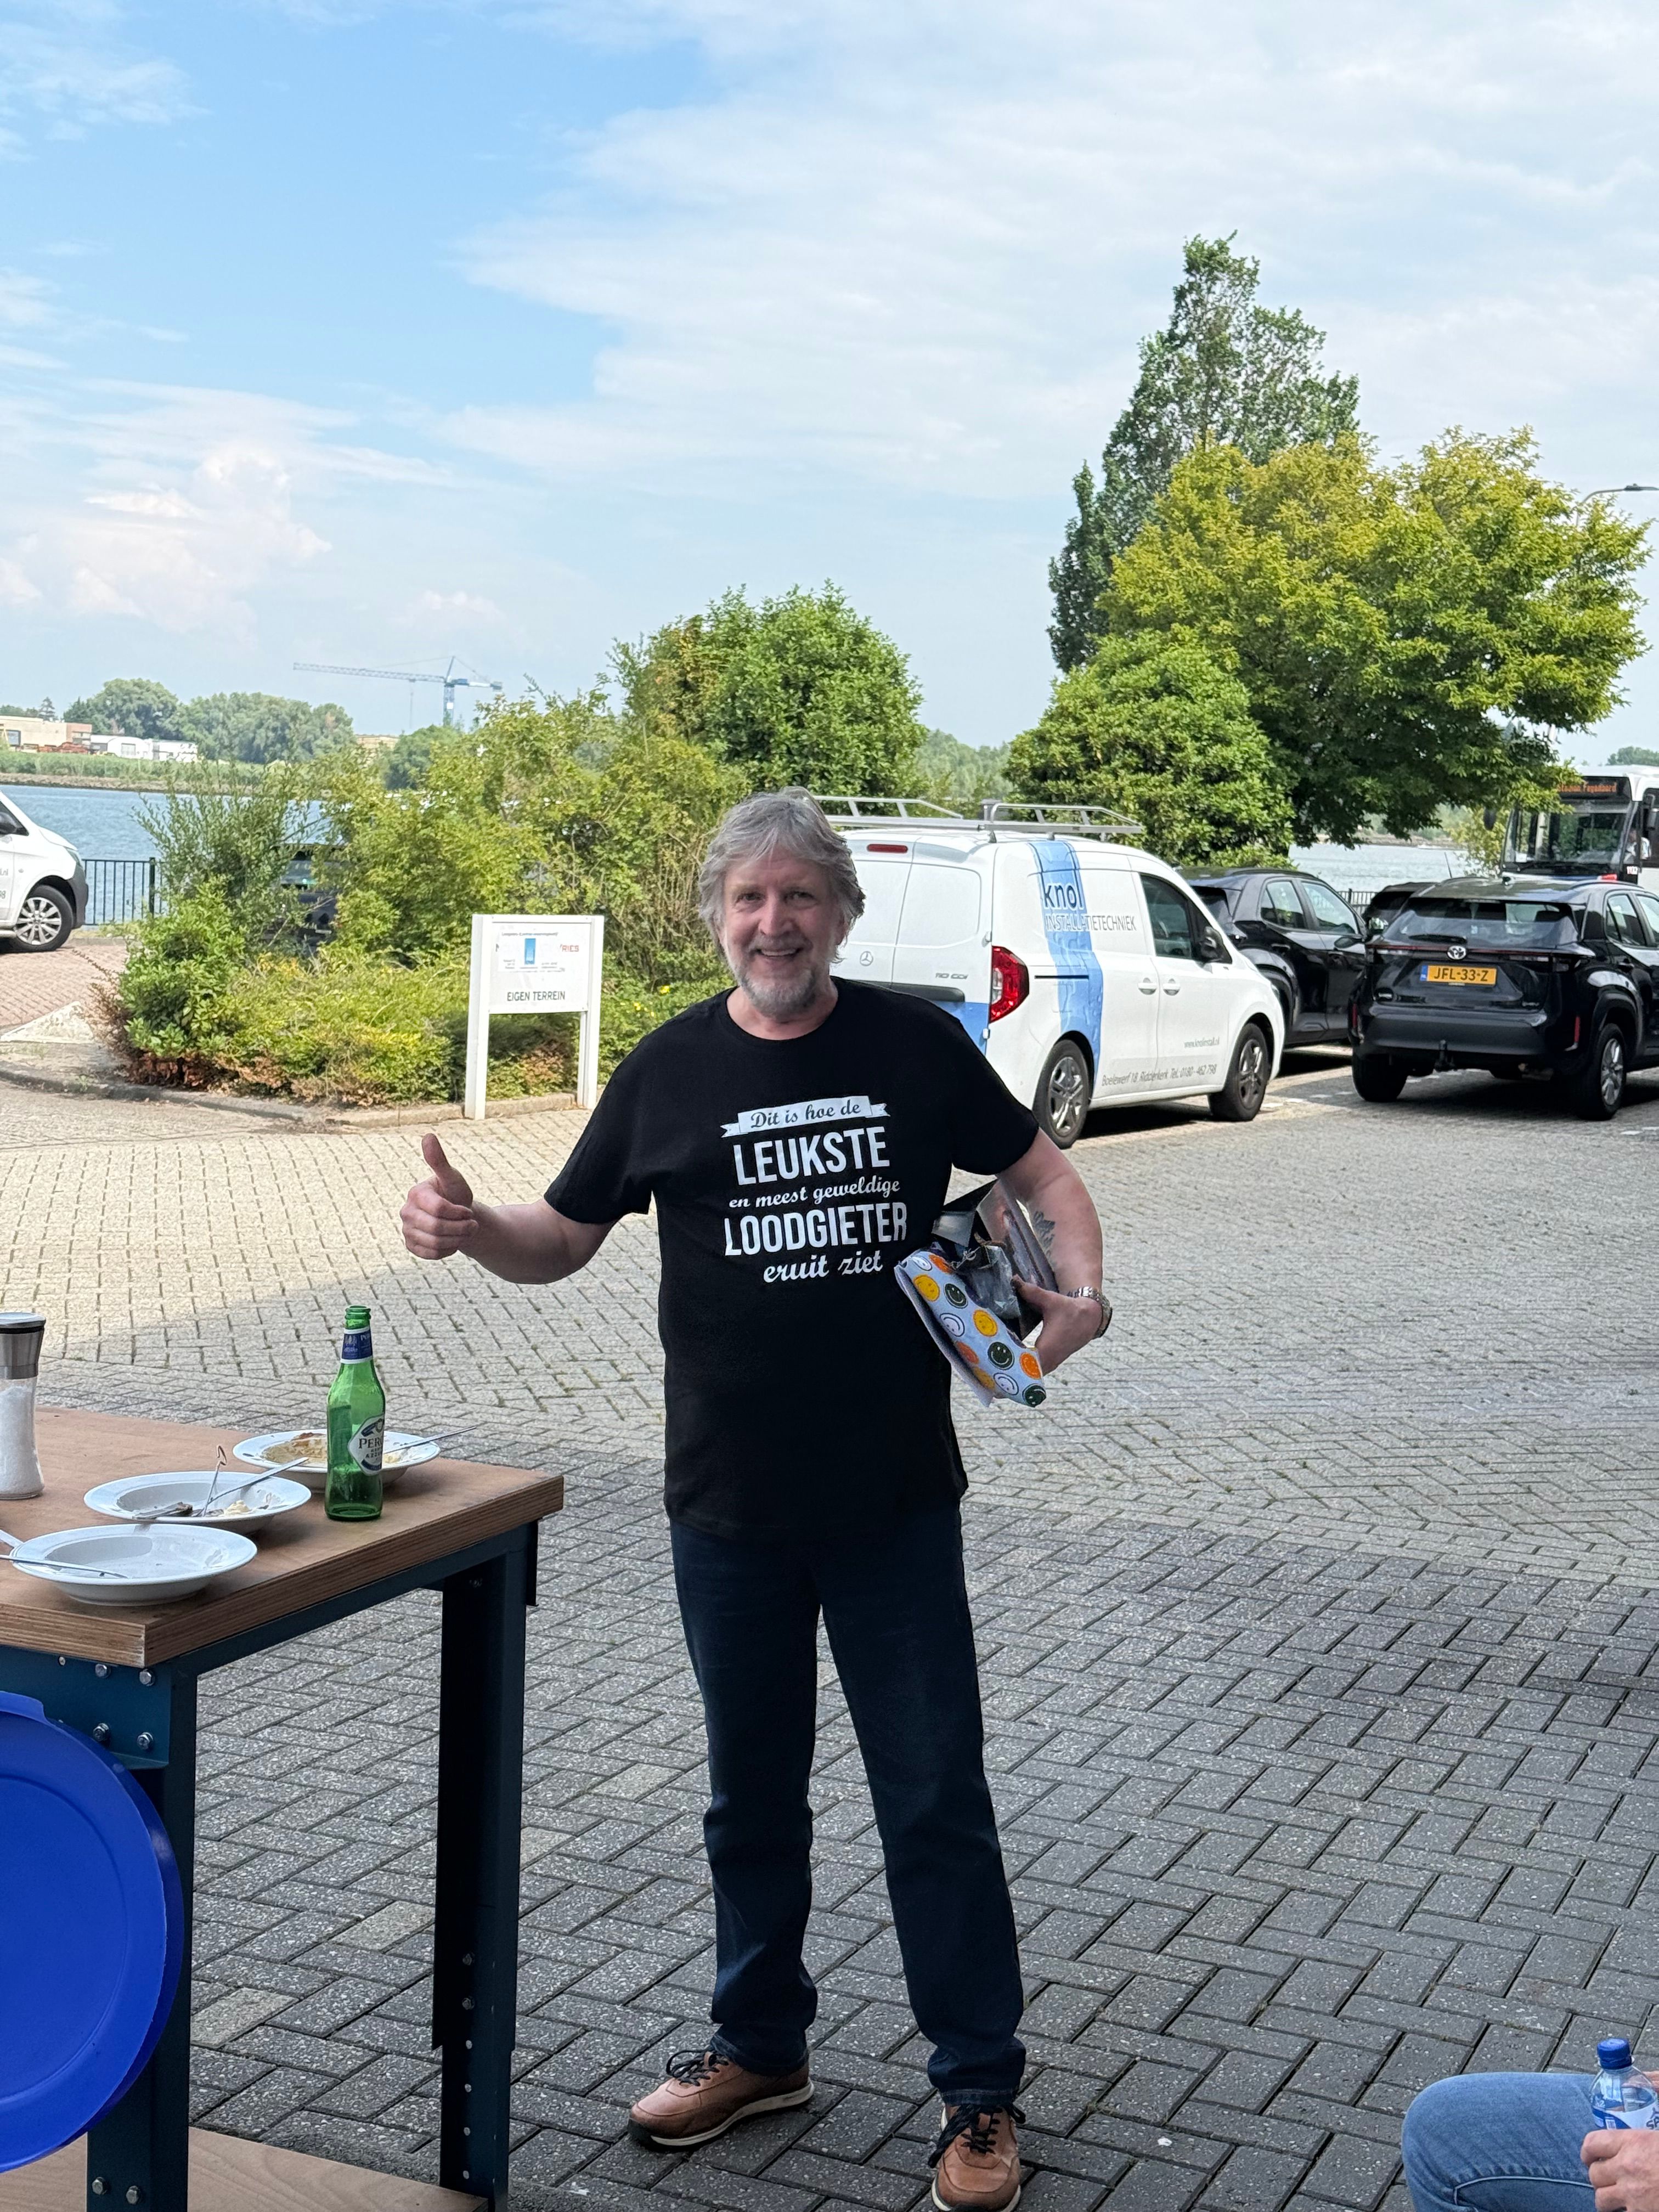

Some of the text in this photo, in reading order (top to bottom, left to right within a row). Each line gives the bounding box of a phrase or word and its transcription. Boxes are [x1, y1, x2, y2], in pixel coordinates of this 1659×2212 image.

[1043, 881, 1084, 909] knol
[1045, 915, 1137, 931] INSTALLATIETECHNIEK
[1434, 967, 1489, 982] JFL-33-Z
[507, 990, 566, 1001] EIGEN TERREIN
[1139, 1069, 1169, 1082] Ridderkerk
[751, 1099, 861, 1128] Dit is hoe de
[732, 1126, 890, 1186] LEUKSTE
[729, 1175, 900, 1208] en meest geweldige
[724, 1202, 907, 1256] LOODGIETER
[763, 1249, 883, 1283] eruit ziet
